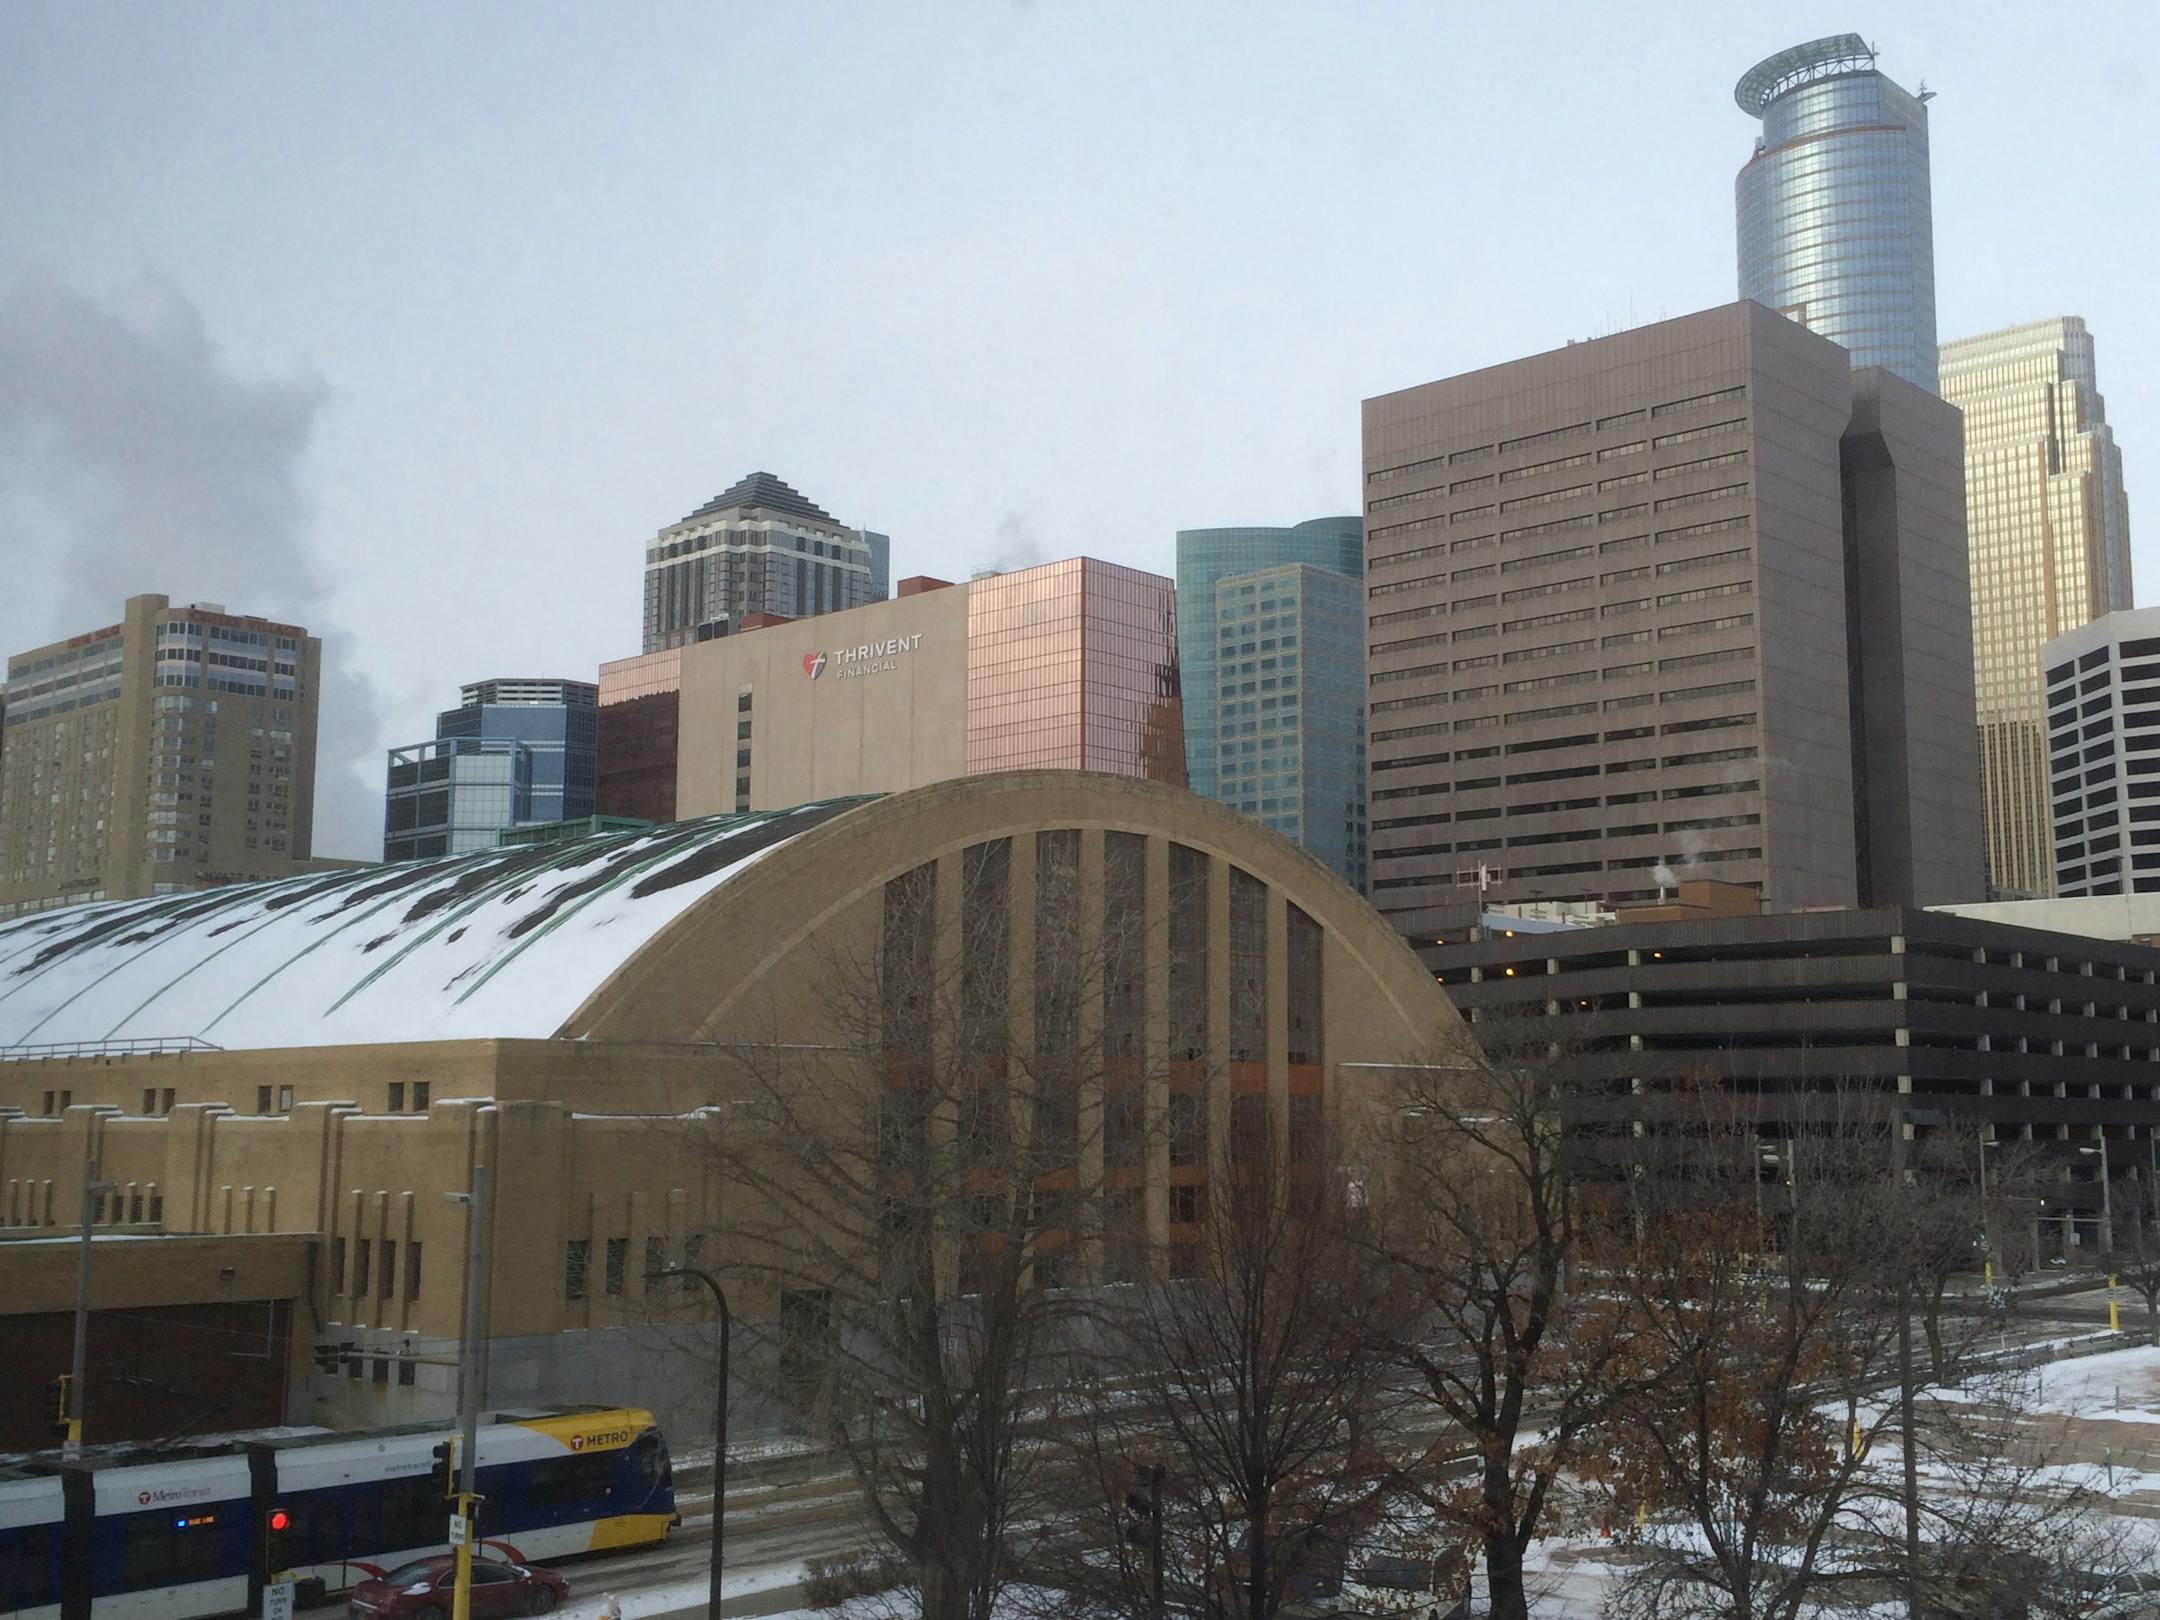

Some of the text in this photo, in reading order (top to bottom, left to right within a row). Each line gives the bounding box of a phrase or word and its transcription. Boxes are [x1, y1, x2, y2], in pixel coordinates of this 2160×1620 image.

[834, 634, 923, 665] THRIVENT
[837, 661, 898, 680] FINANCIAL
[587, 1431, 629, 1446] METRO
[272, 1587, 285, 1596] NO
